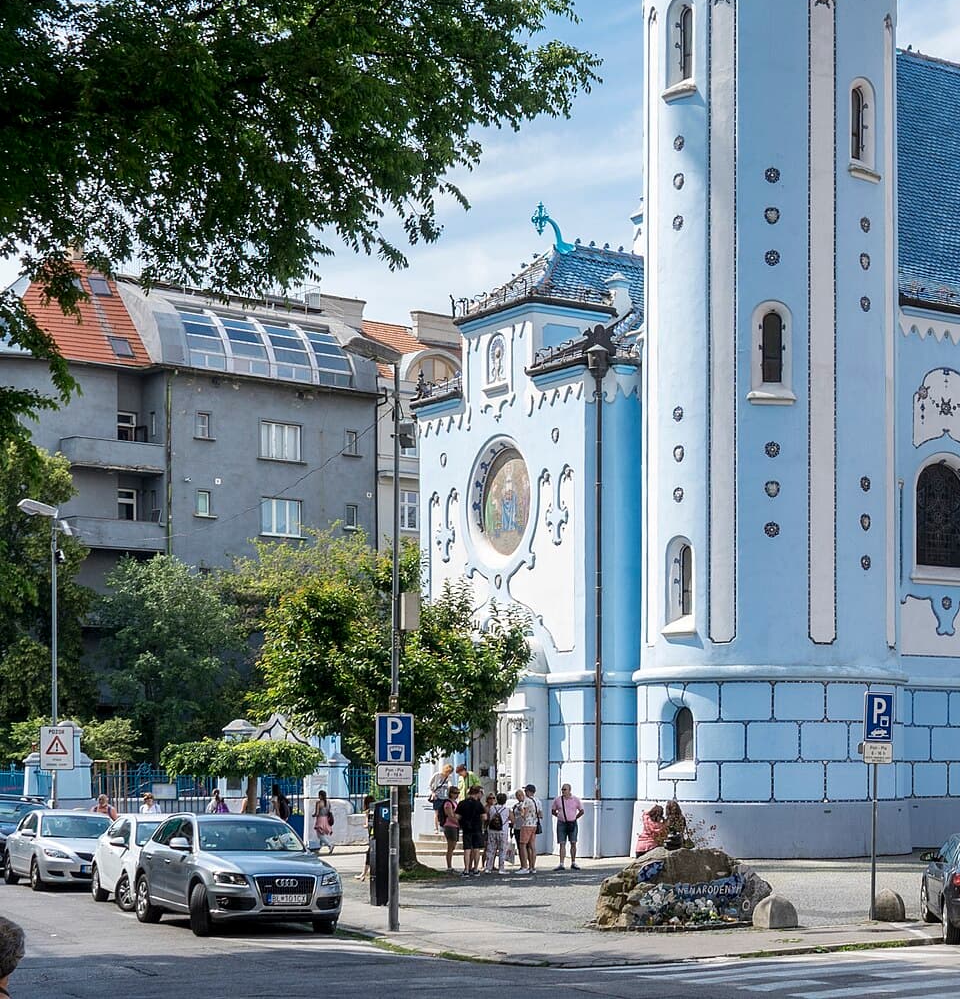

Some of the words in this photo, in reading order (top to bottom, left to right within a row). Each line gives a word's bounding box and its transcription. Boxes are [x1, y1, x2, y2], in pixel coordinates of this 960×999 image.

[873, 698, 887, 724] P
[387, 717, 403, 743] P
[382, 808, 389, 818] P
